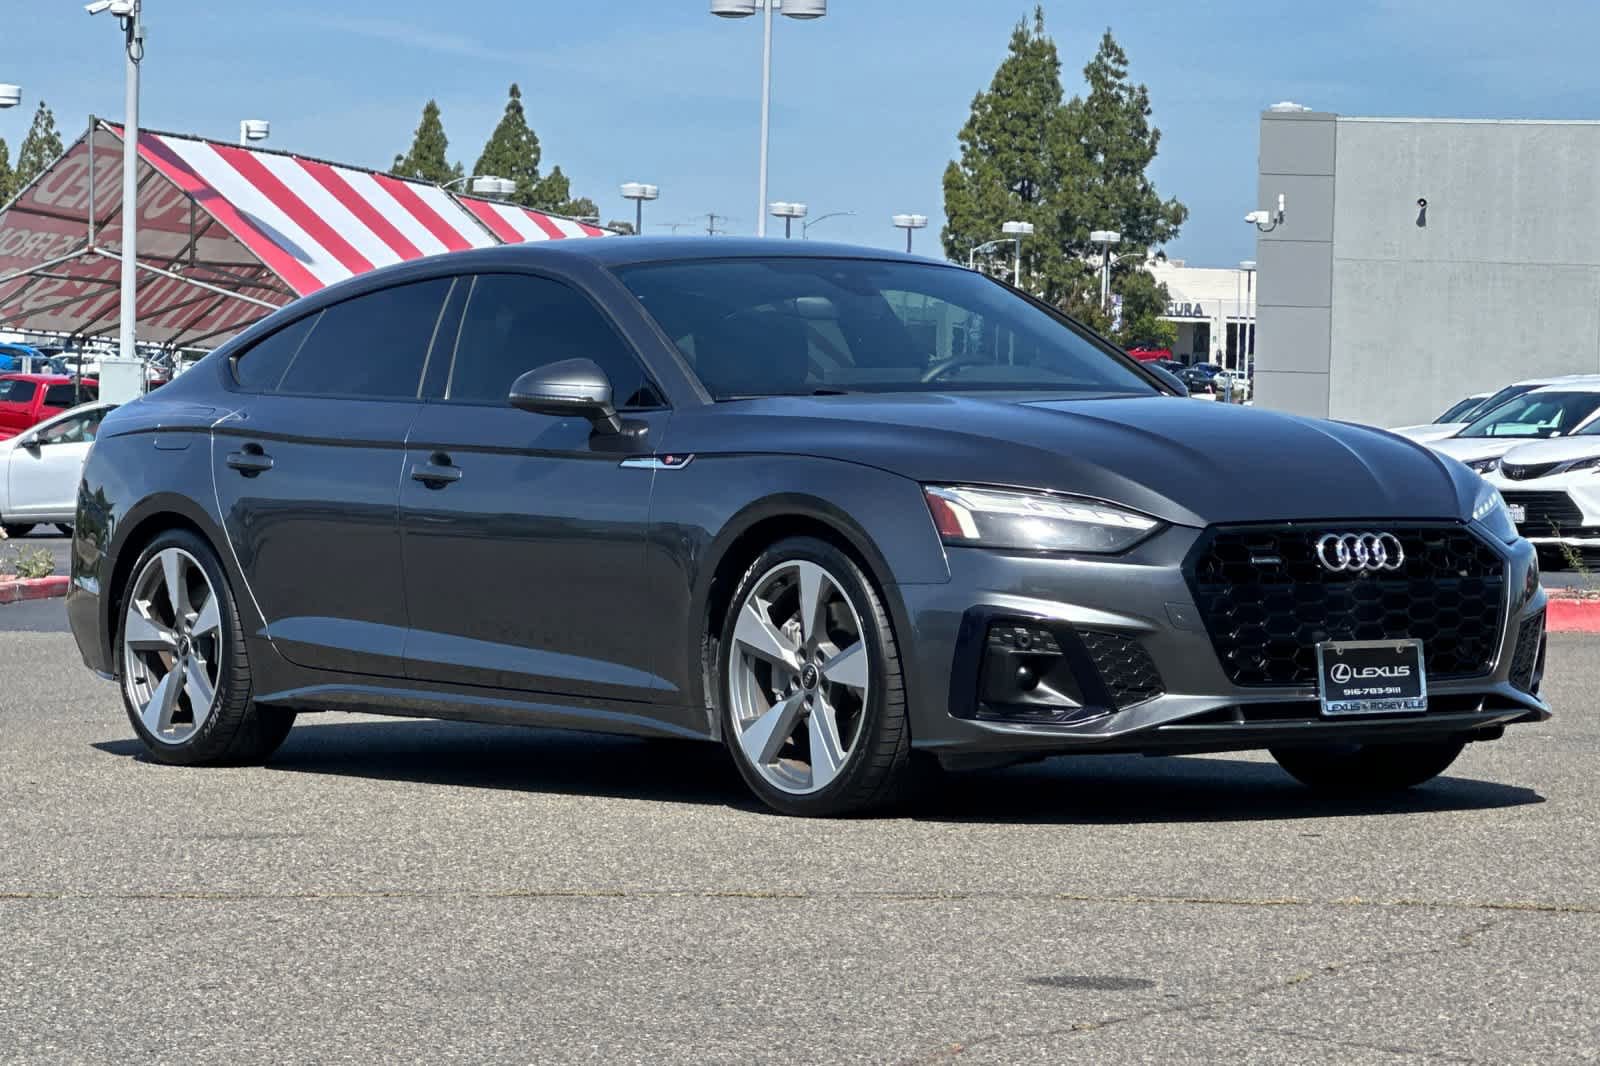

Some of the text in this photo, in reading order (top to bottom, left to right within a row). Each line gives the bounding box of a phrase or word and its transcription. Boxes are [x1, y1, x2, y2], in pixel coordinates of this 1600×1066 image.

[1166, 302, 1203, 316] CURA
[1353, 665, 1410, 678] LEXUS
[1343, 687, 1401, 696] 916-783-9111
[1326, 703, 1360, 712] LEXUS
[1370, 700, 1425, 711] ROSEVILLE
